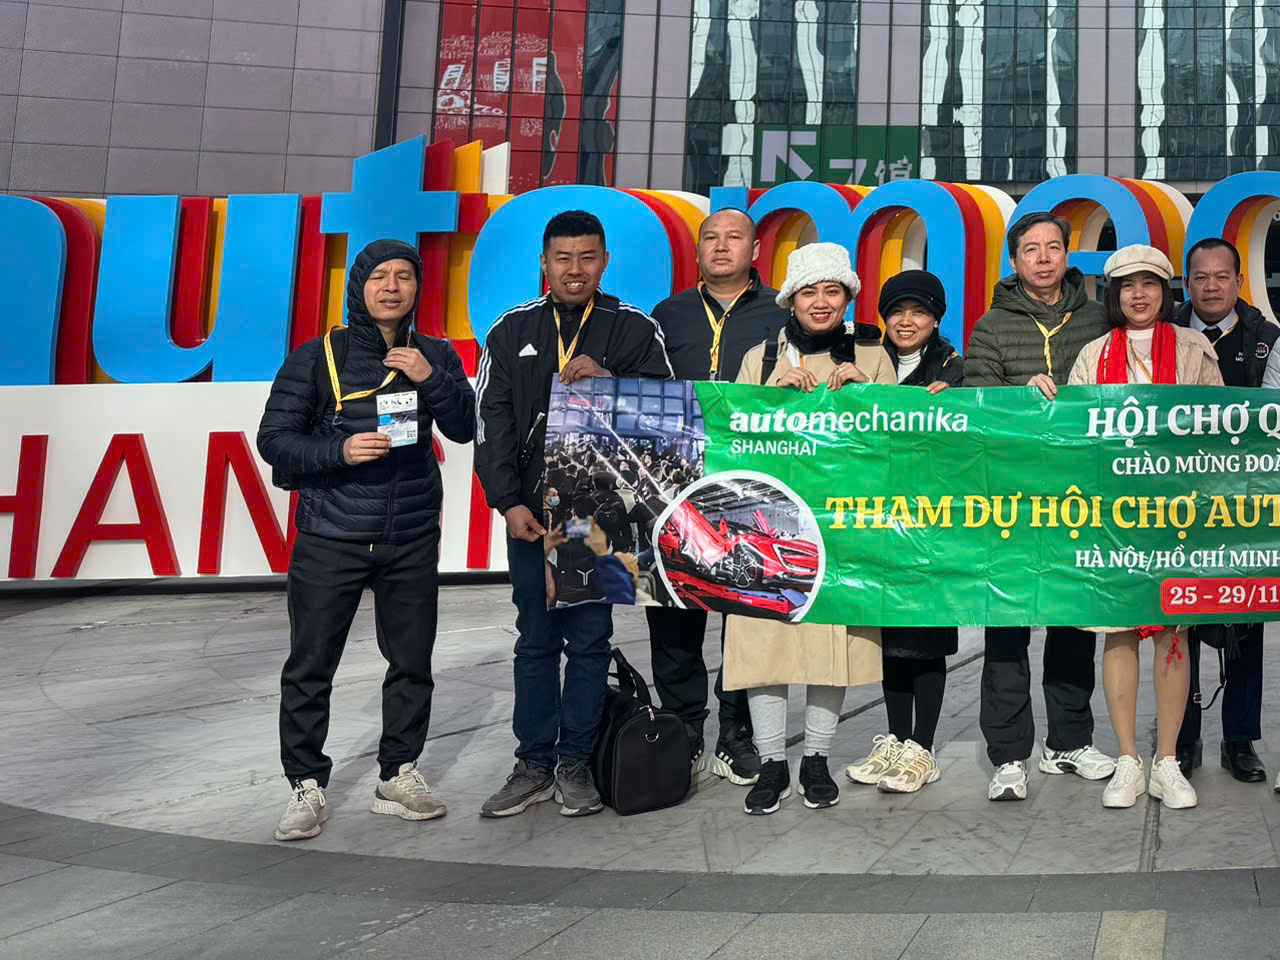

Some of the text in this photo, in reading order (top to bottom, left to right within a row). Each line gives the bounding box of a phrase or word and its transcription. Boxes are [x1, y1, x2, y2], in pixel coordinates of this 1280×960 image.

[729, 403, 969, 433] automechanika
[1086, 396, 1158, 448] HỘI
[1168, 400, 1250, 445] CHỢ
[730, 439, 817, 456] SHANGHAI
[1112, 450, 1171, 476] CHÀO
[1175, 449, 1240, 474] MỪNG
[825, 495, 953, 529] THAM
[963, 491, 1024, 539] DỰ
[1030, 484, 1103, 539] HỘI
[1112, 490, 1198, 539] CHỢ
[1075, 543, 1104, 568] HÀ
[1189, 543, 1226, 567] CHÍ
[1170, 586, 1198, 606] 25
